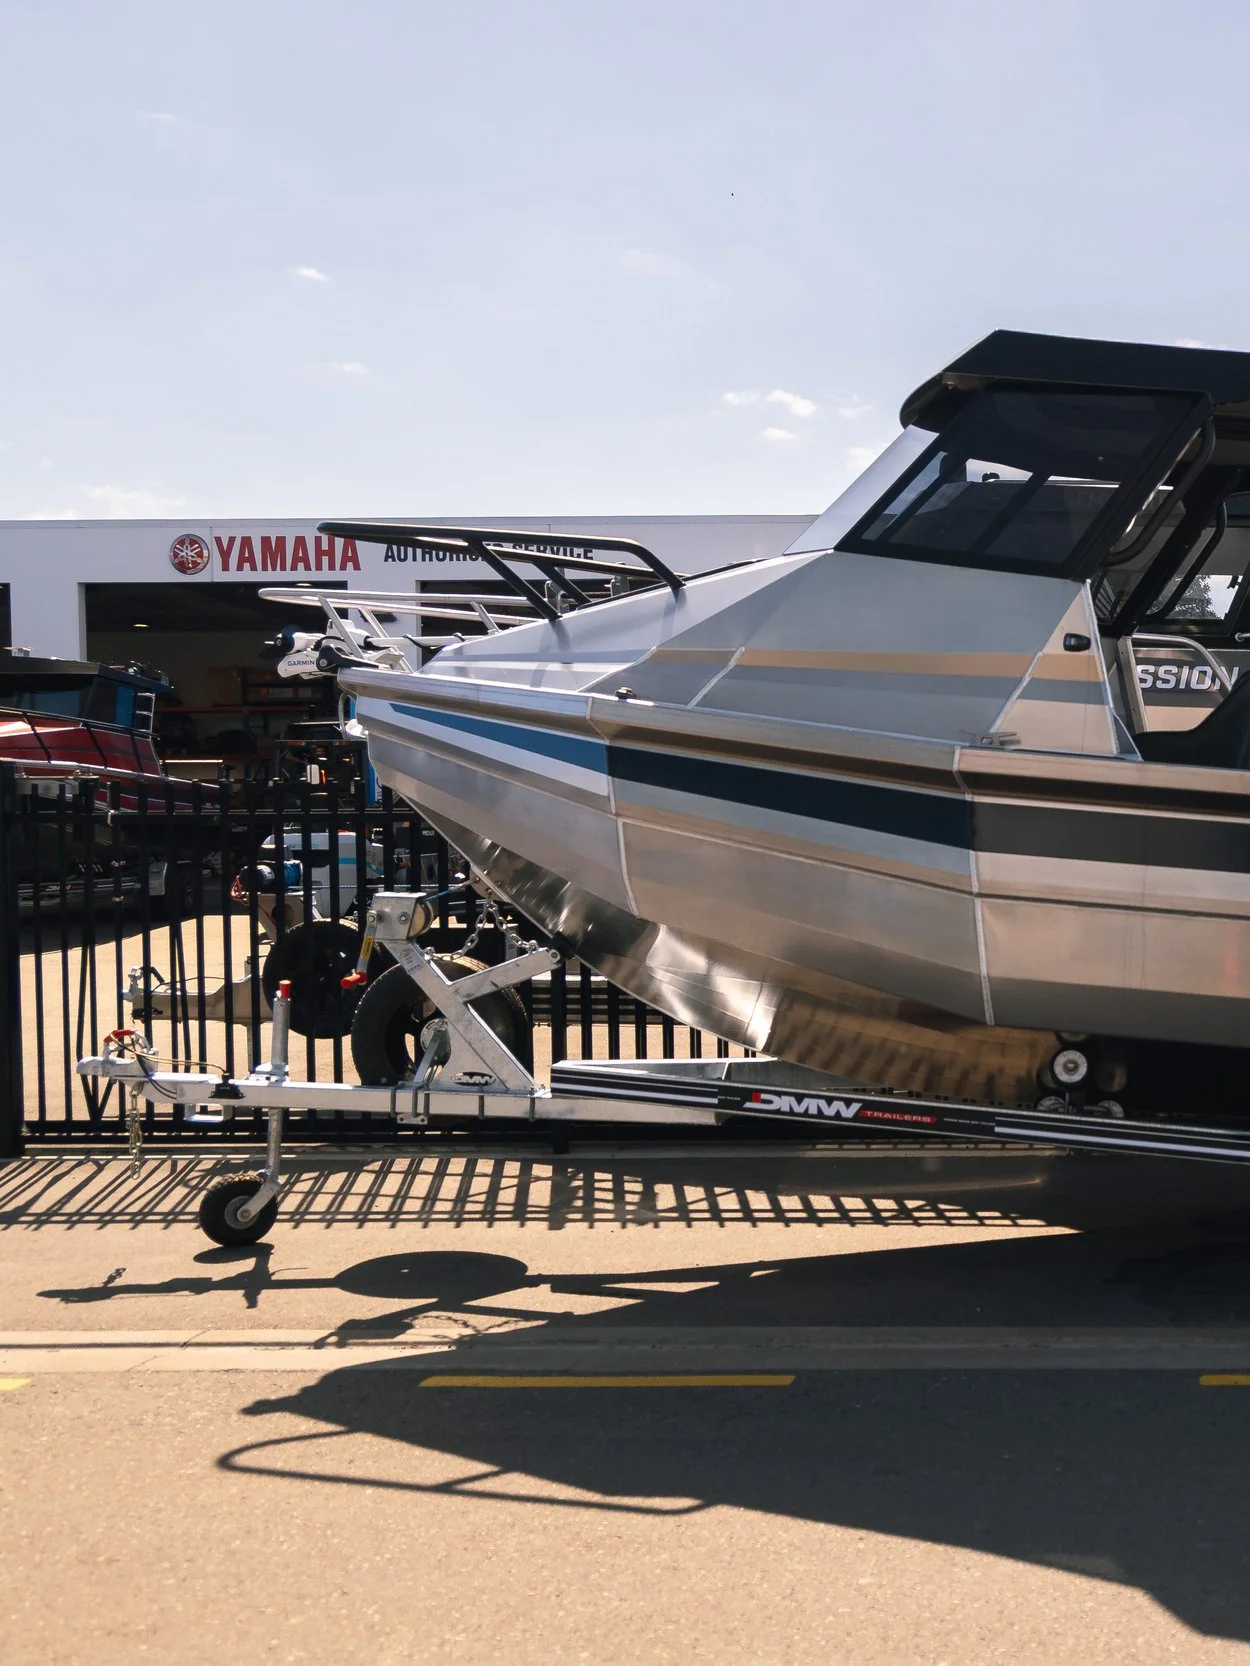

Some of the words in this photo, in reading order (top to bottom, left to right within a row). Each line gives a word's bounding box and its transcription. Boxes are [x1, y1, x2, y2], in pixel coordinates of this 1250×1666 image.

[214, 536, 361, 571] YAMAHA
[743, 1092, 862, 1118] DMW
[865, 1111, 932, 1123] TRAILERS
